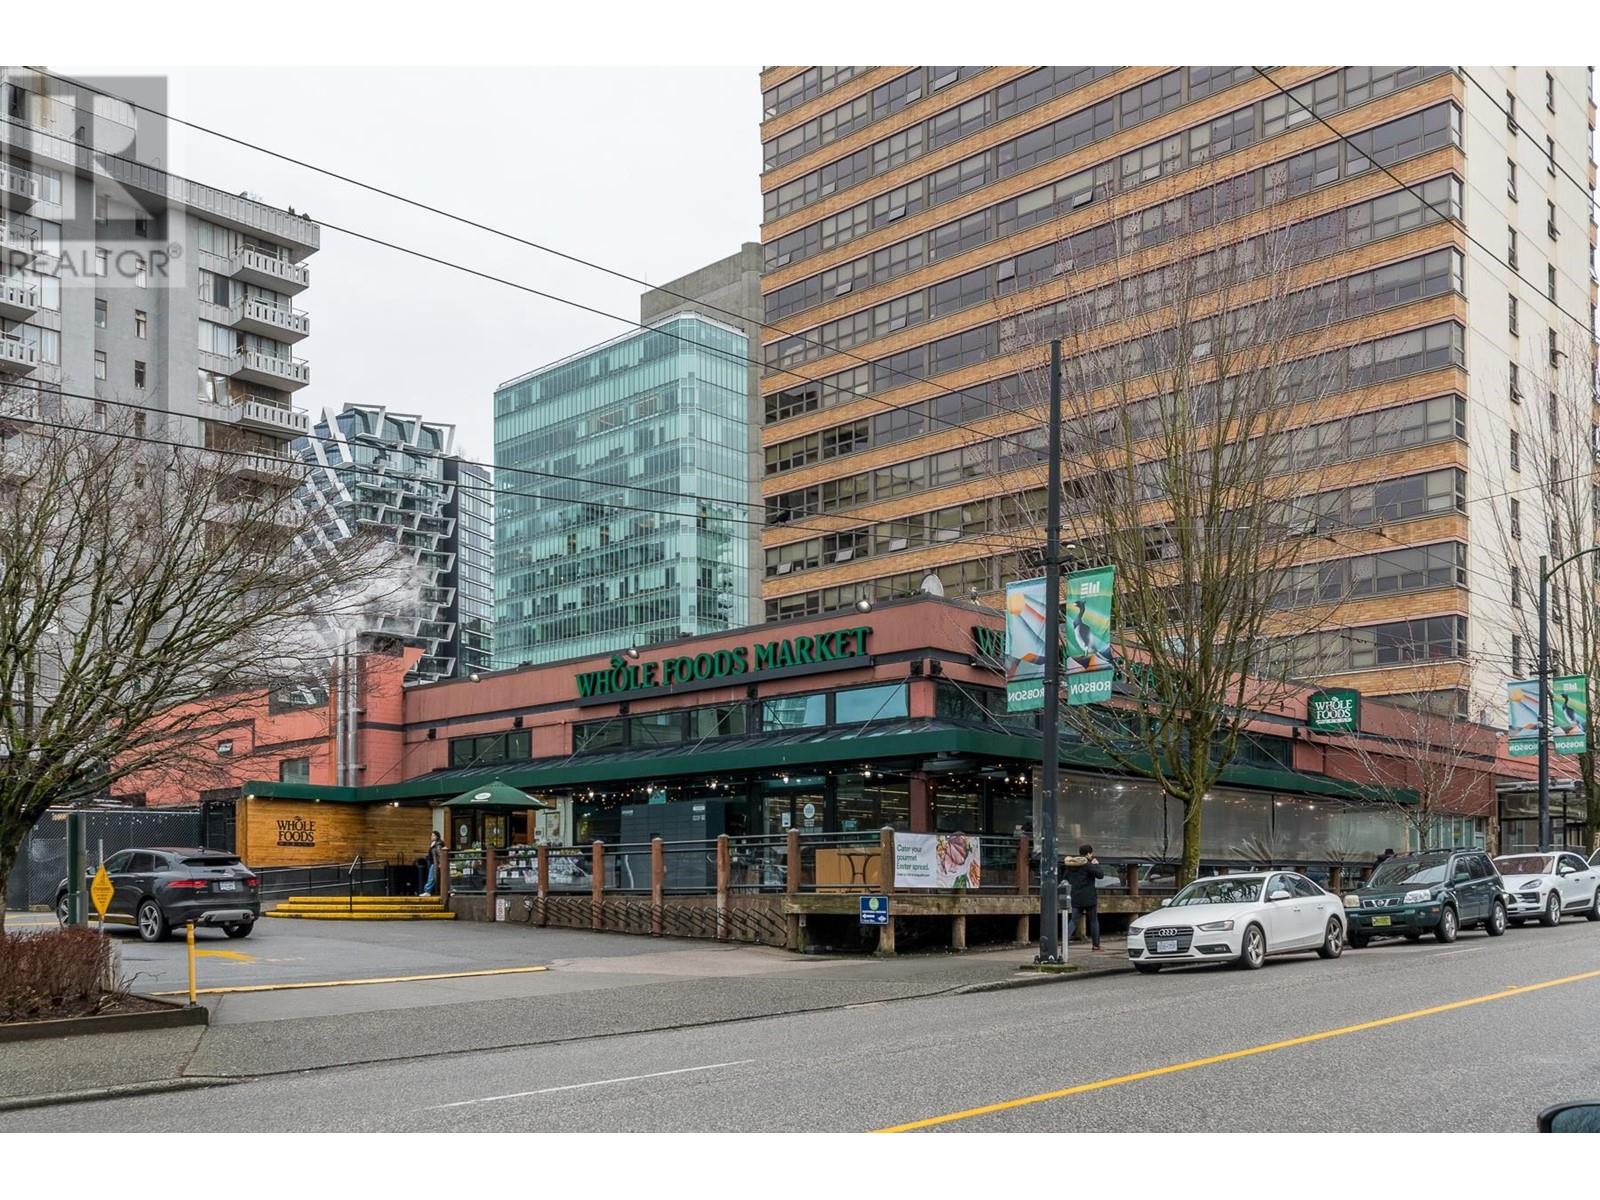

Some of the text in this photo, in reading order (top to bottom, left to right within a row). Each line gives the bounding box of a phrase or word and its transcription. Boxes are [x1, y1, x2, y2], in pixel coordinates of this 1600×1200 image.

[575, 626, 872, 698] WHOLE FOODS MARKET
[1315, 699, 1352, 711] WHOLE
[1316, 708, 1351, 720] FOODS
[276, 819, 316, 832] WHOLE
[278, 830, 315, 842] FOODS
